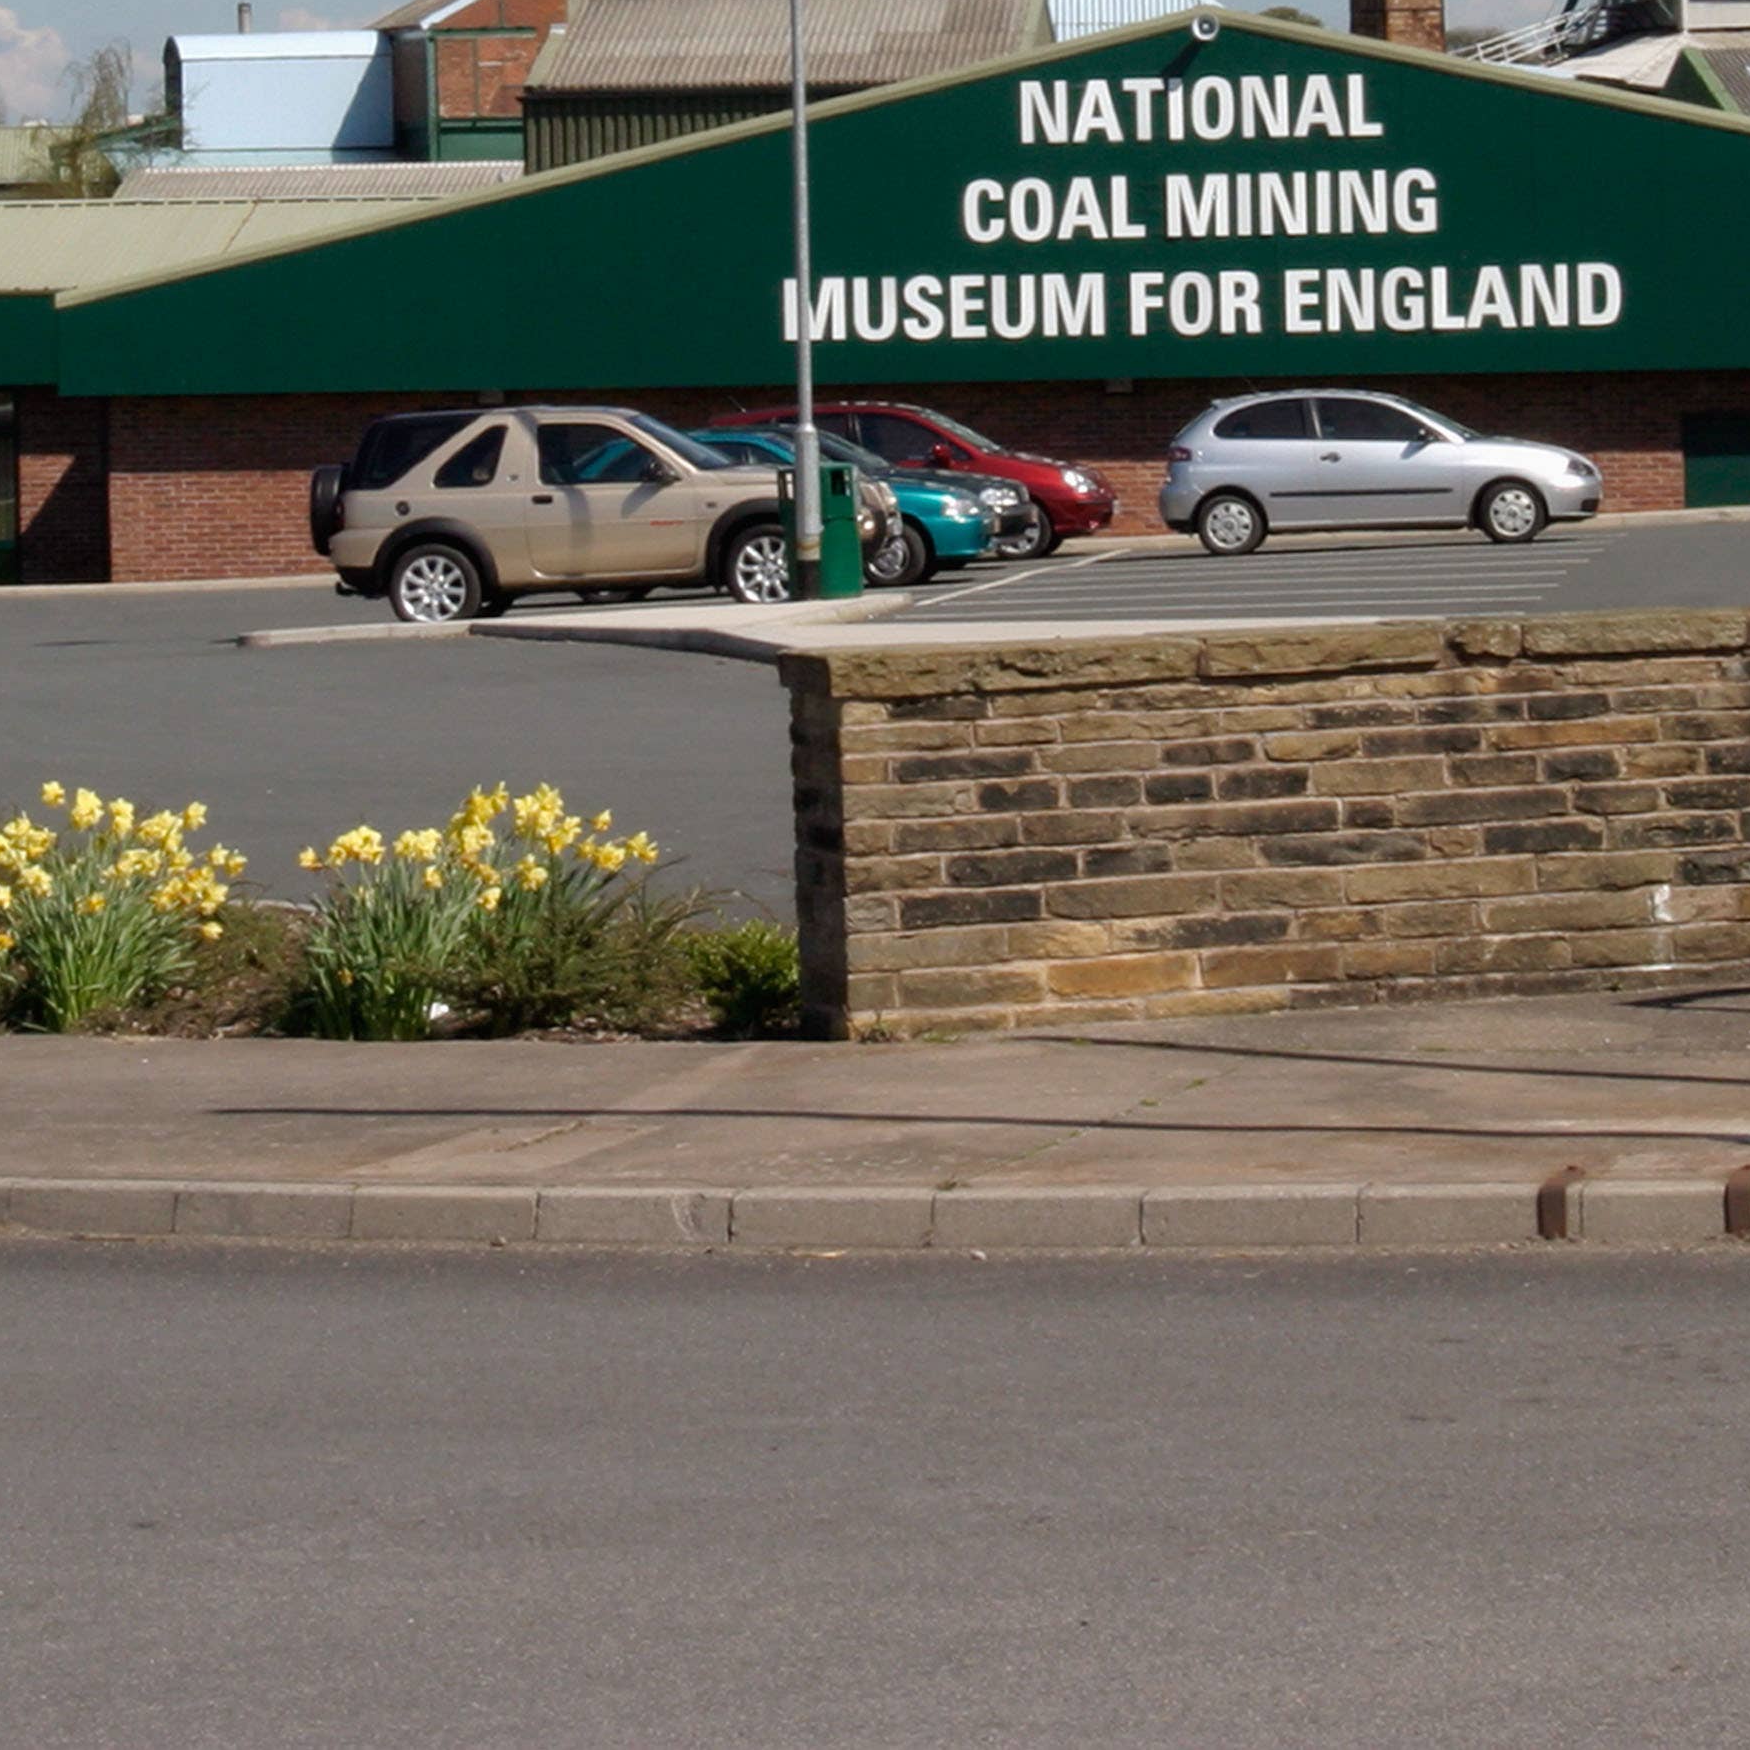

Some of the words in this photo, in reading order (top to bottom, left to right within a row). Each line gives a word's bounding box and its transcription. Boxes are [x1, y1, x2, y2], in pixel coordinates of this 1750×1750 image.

[1019, 74, 1384, 145] NATIONAL
[963, 175, 1147, 245] COAL
[1166, 168, 1439, 239] MINING
[782, 272, 1107, 342] MUSEUM
[1129, 268, 1263, 336] FOR
[1284, 262, 1624, 335] ENGLAND
